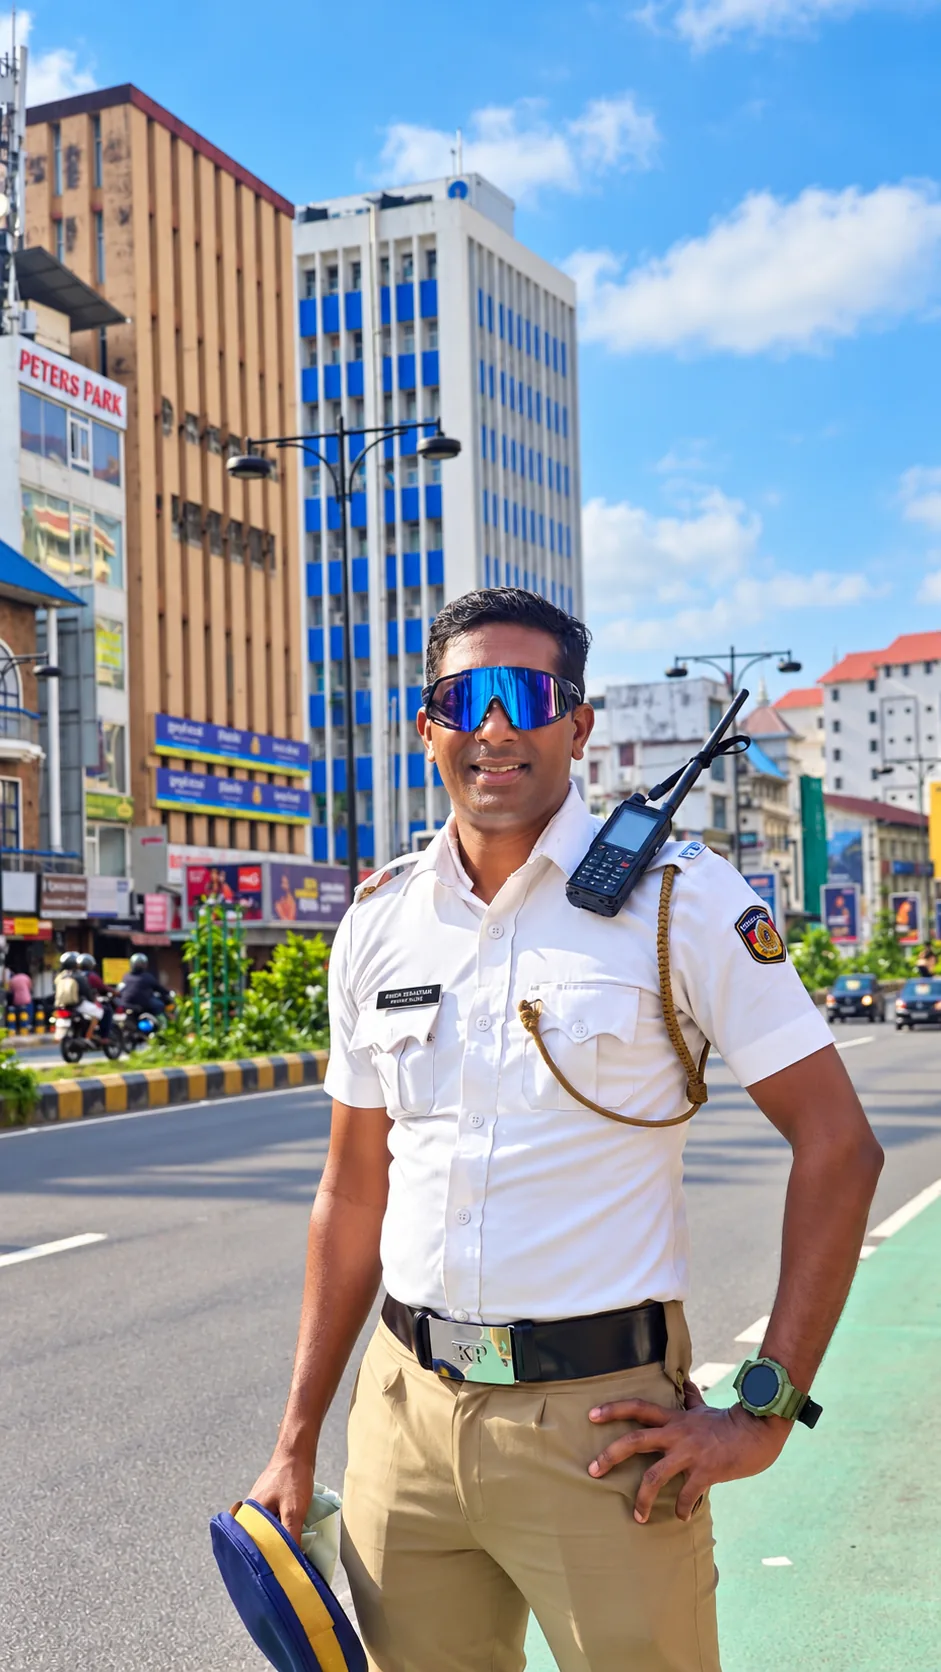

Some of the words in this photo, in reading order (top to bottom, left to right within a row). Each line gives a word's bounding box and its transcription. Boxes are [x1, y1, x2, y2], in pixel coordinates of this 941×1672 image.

[19, 349, 80, 397] PETERS
[83, 380, 123, 417] PARK
[452, 1341, 488, 1364] KP
